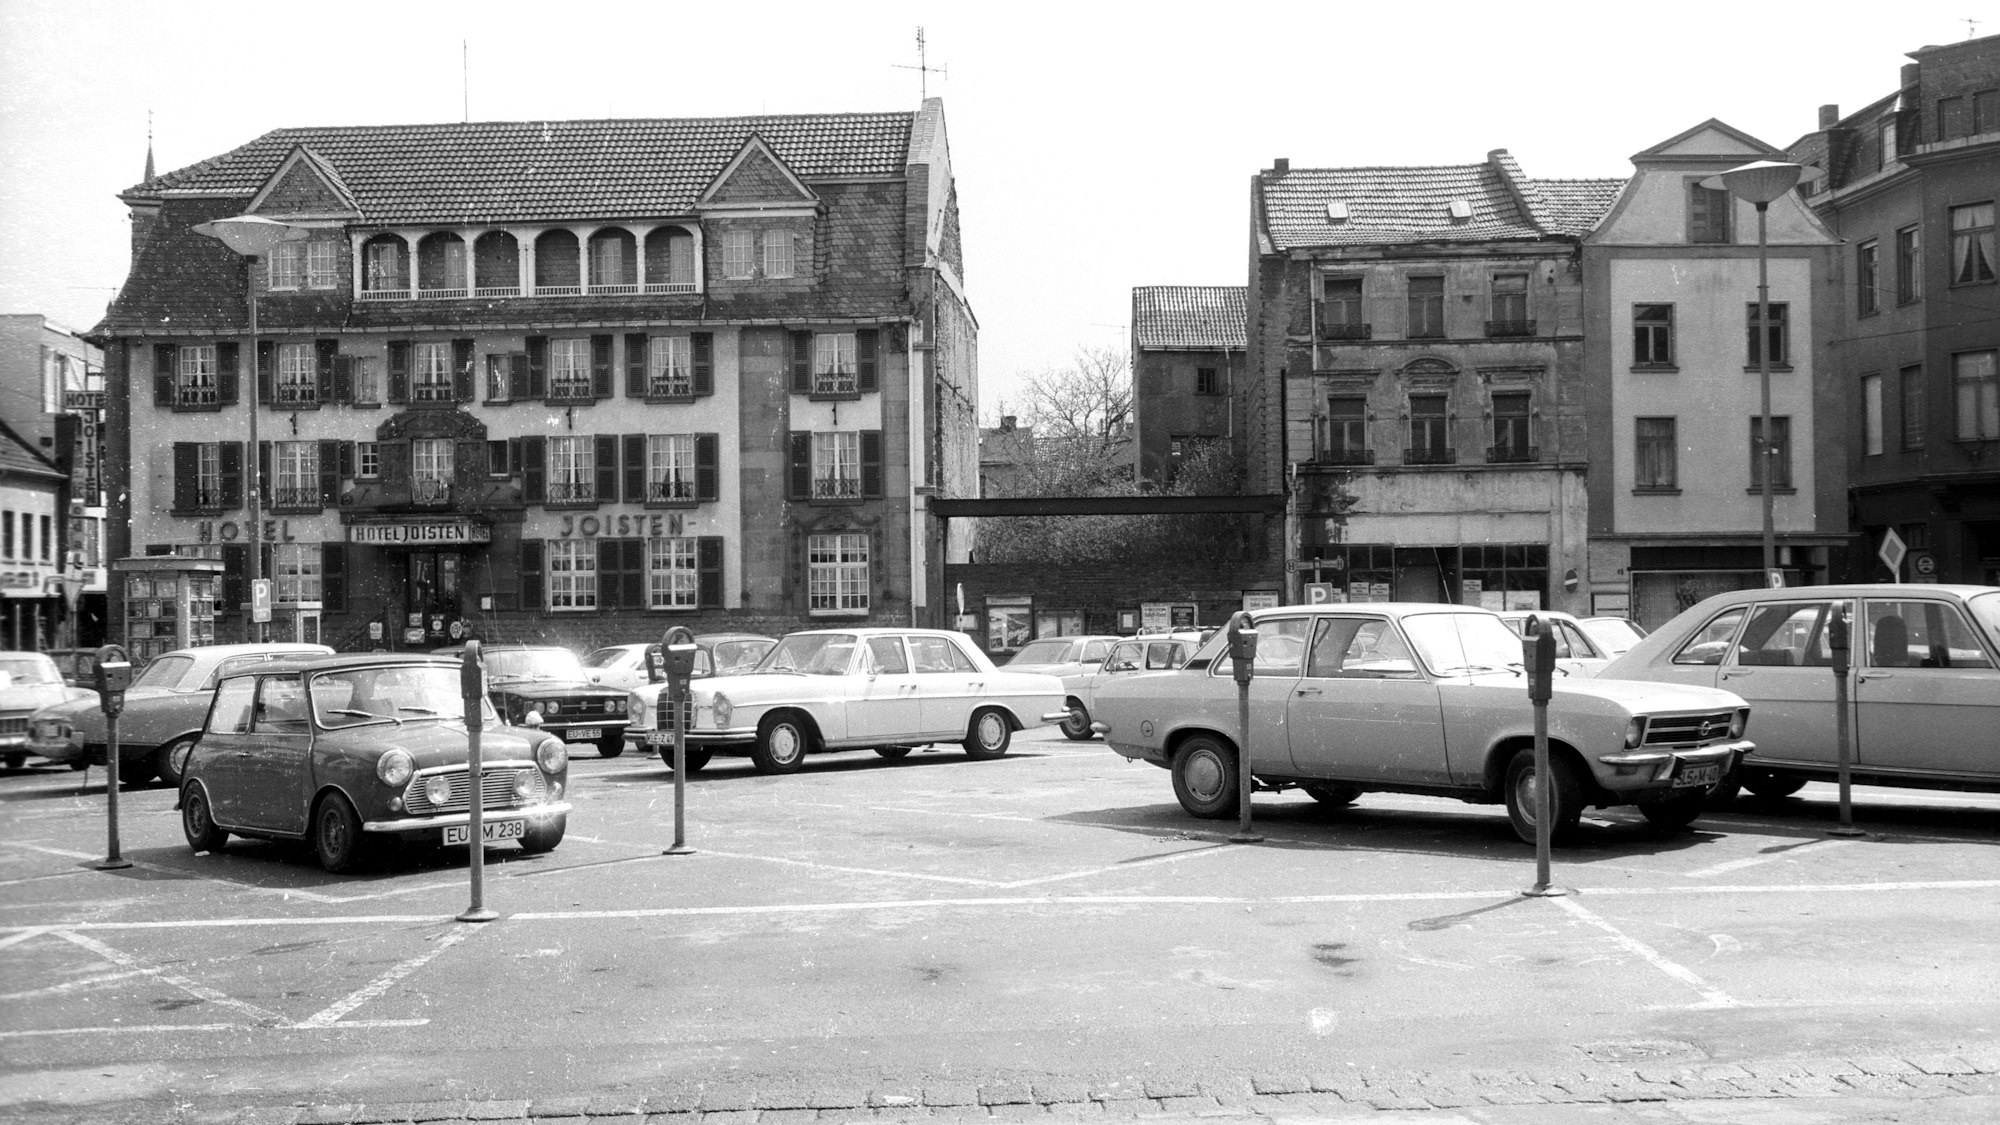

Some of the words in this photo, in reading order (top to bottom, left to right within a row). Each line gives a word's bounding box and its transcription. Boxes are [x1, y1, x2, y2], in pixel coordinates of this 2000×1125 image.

[65, 392, 104, 407] HOTE
[83, 411, 96, 504] JOISTEN
[200, 520, 295, 542] HOEL
[356, 526, 400, 541] HOTEL
[403, 525, 465, 542] JOISTEN
[1771, 572, 1782, 589] P
[255, 583, 267, 607] P
[1310, 587, 1327, 606] P
[498, 822, 522, 838] 238
